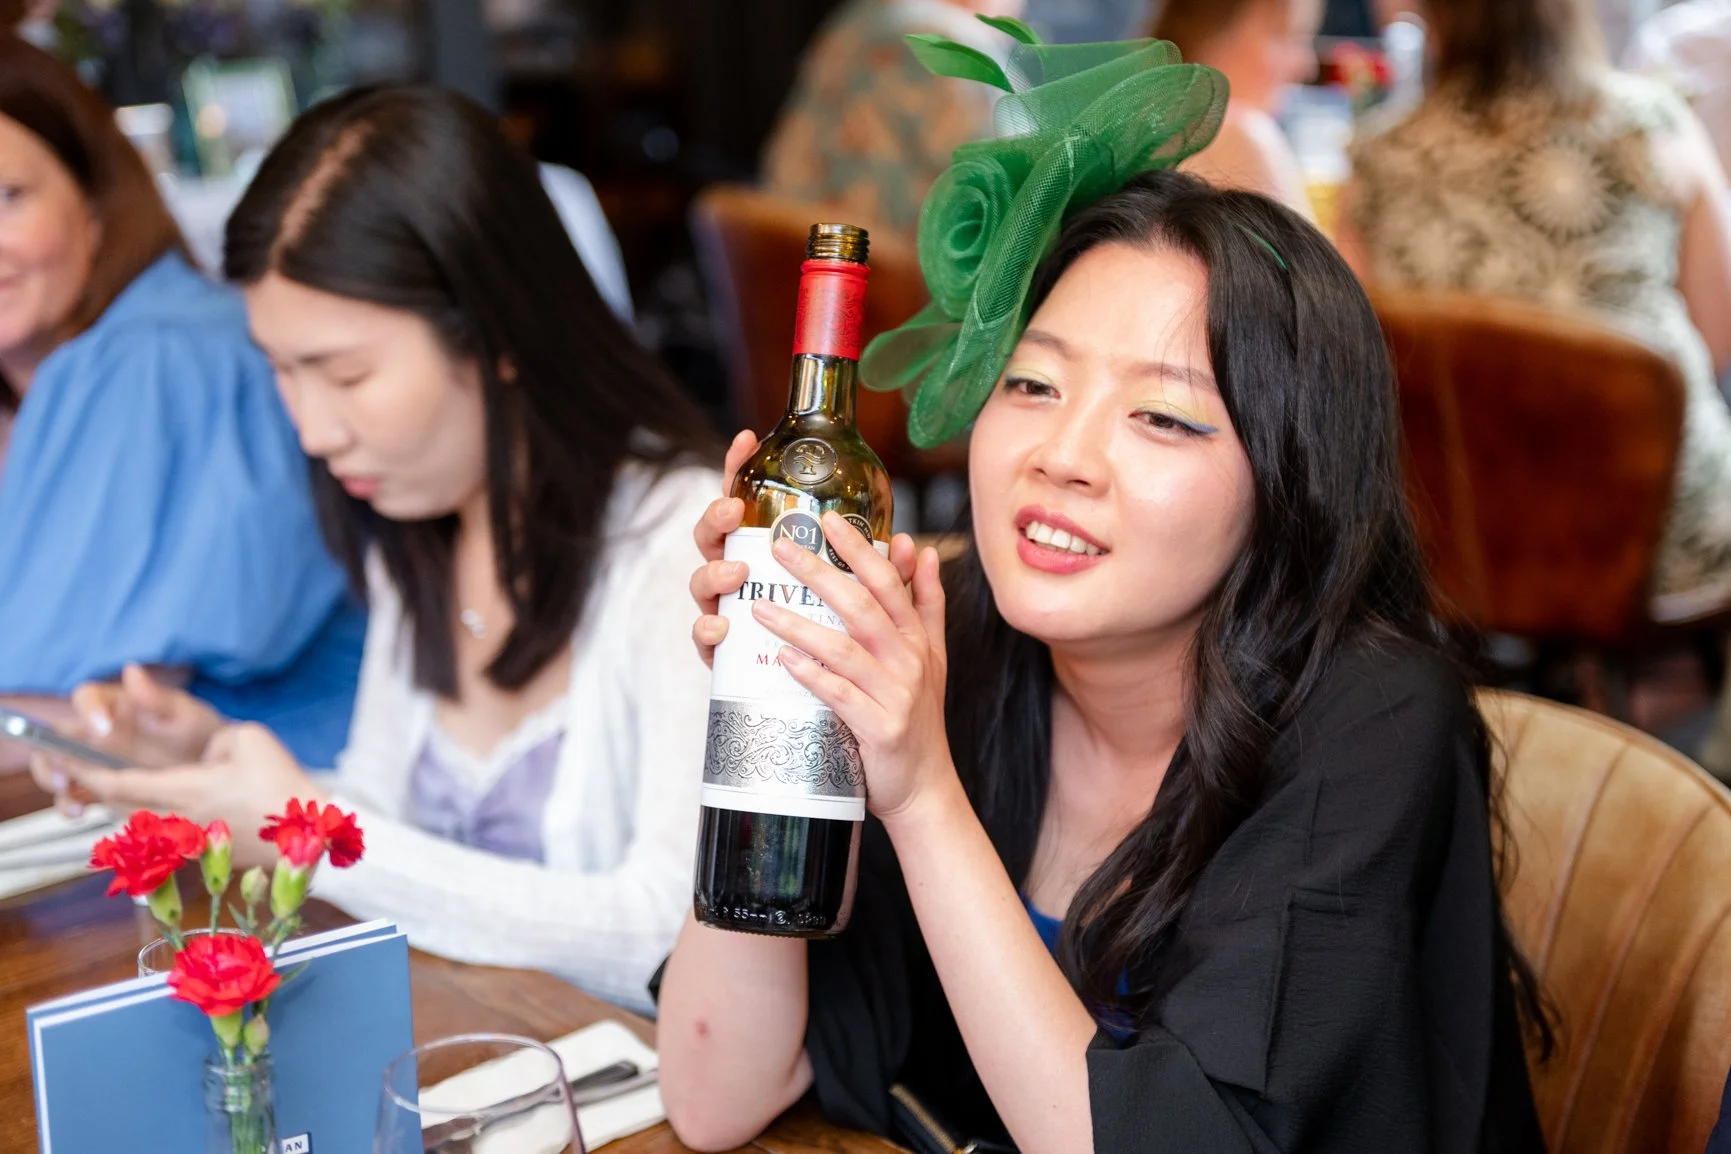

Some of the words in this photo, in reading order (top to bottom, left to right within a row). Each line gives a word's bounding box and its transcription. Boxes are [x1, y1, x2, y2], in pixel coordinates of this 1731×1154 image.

[737, 581, 825, 607] TRIVE
[756, 653, 782, 667] MA
[285, 1140, 303, 1153] AN
